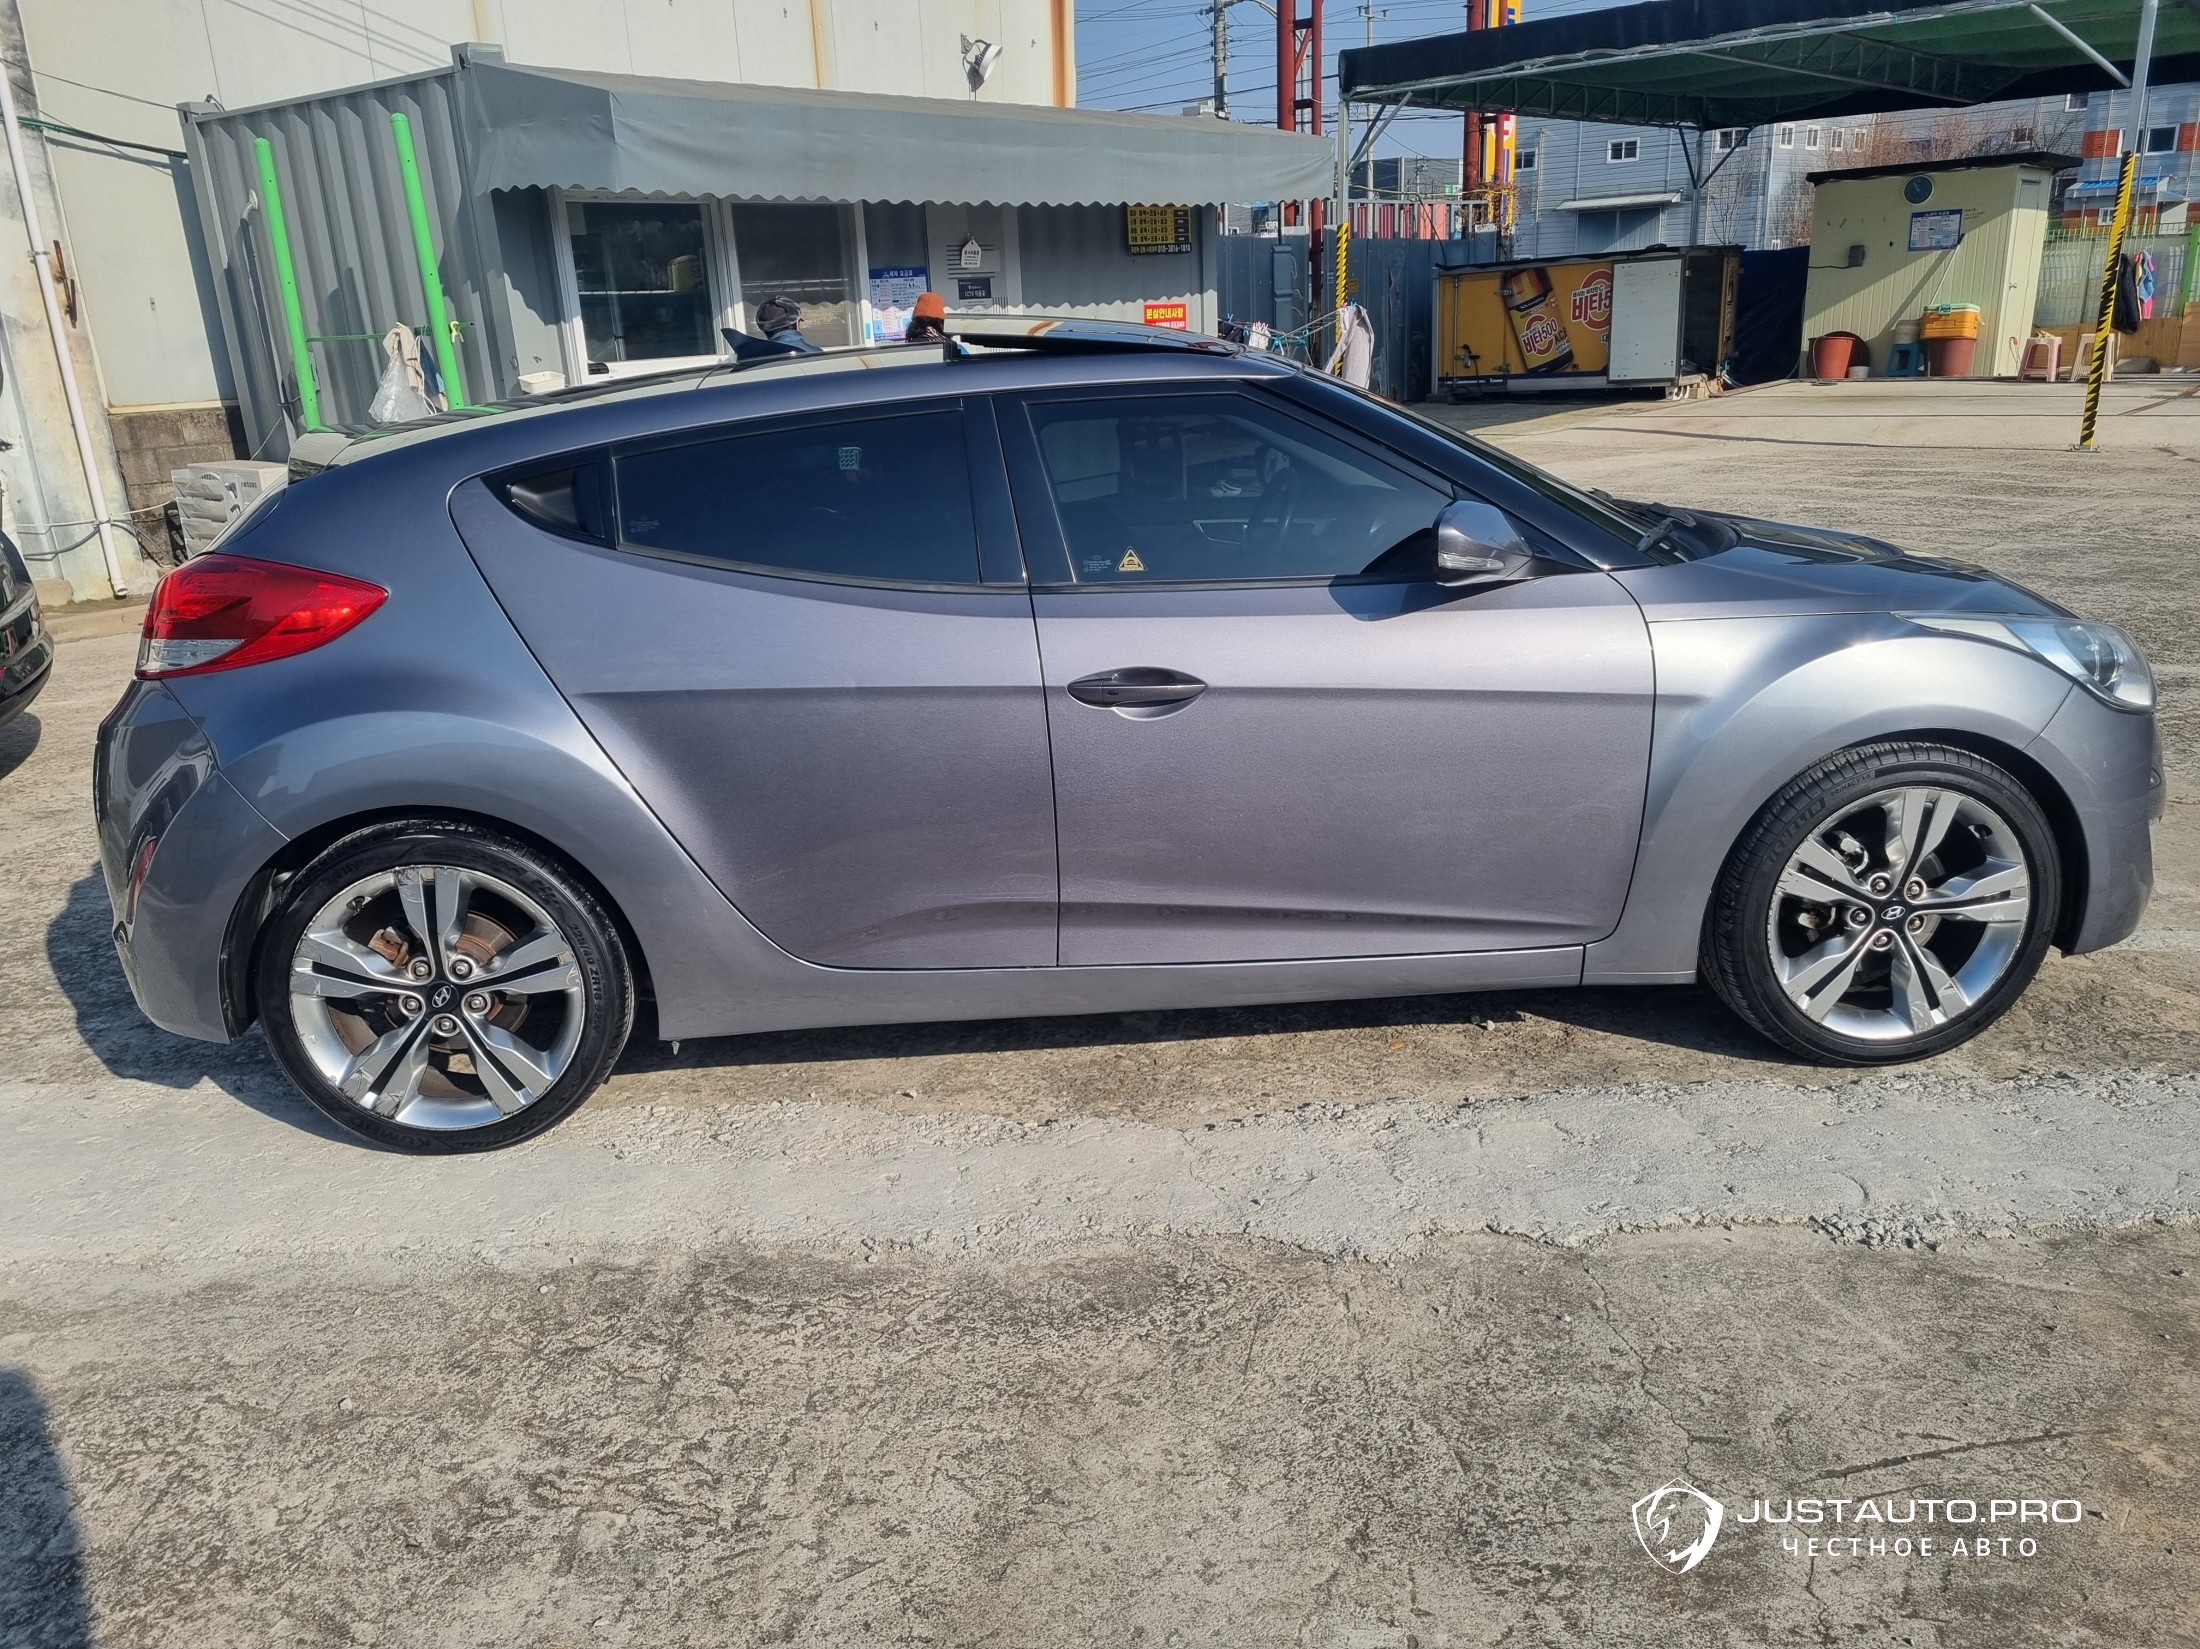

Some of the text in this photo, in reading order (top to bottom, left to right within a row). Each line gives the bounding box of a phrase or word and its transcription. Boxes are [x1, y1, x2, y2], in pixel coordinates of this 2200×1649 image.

[900, 269, 913, 277] 요금표
[1830, 777, 1862, 798] PRIMACY
[569, 922, 595, 966] 225/40
[589, 967, 603, 1001] ZR18
